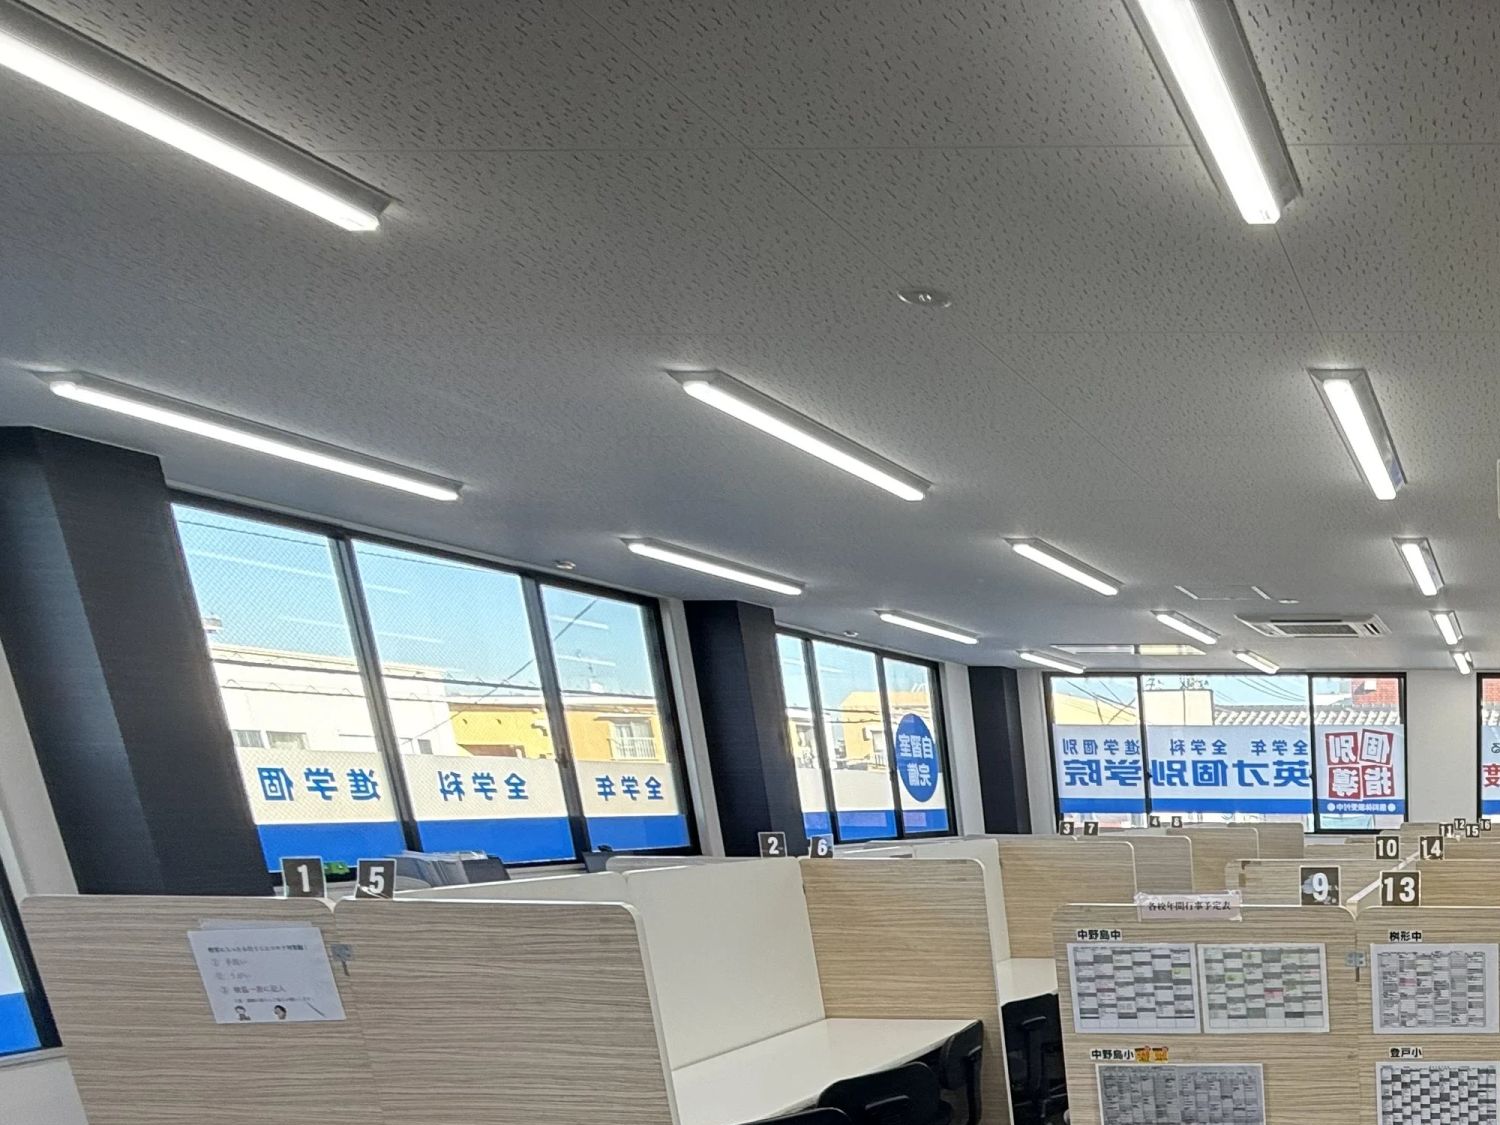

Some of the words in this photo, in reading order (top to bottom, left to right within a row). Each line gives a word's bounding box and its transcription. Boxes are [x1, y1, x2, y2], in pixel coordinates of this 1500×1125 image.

[1152, 817, 1158, 826] 4
[1173, 817, 1180, 826] 8
[1454, 819, 1465, 830] 12
[1480, 819, 1491, 830] 16
[1063, 823, 1070, 834] 3
[1088, 823, 1094, 834] 7
[1440, 825, 1453, 836] 11
[1466, 825, 1479, 836] 15
[767, 836, 780, 855] 2
[817, 839, 828, 856] 6
[1377, 839, 1397, 857] 10
[1421, 840, 1441, 857] 14
[297, 864, 310, 893] 1
[369, 866, 385, 894] 5
[1312, 872, 1329, 901] 9
[1384, 876, 1416, 902] 13
[1077, 929, 1121, 941] 中野島中
[1091, 1049, 1134, 1060] 中野島小
[1390, 1047, 1422, 1058] 登戸小
